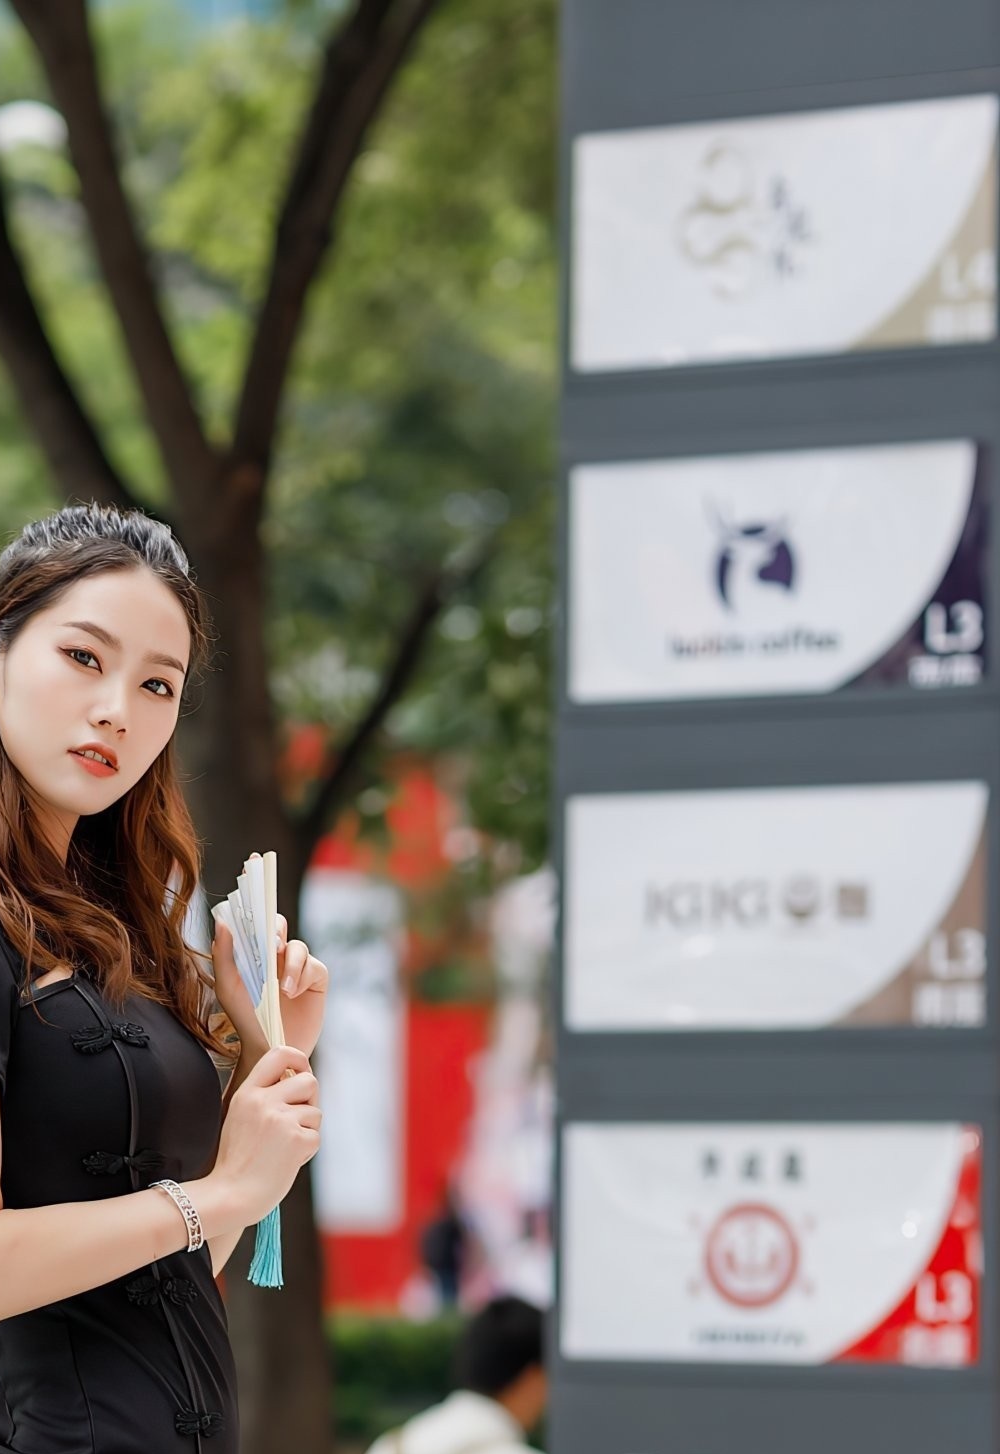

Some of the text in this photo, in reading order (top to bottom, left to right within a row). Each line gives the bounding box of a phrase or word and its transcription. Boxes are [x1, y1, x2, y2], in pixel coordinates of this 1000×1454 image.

[923, 600, 985, 654] L3
[928, 928, 986, 980] L3
[914, 1270, 972, 1323] L3
